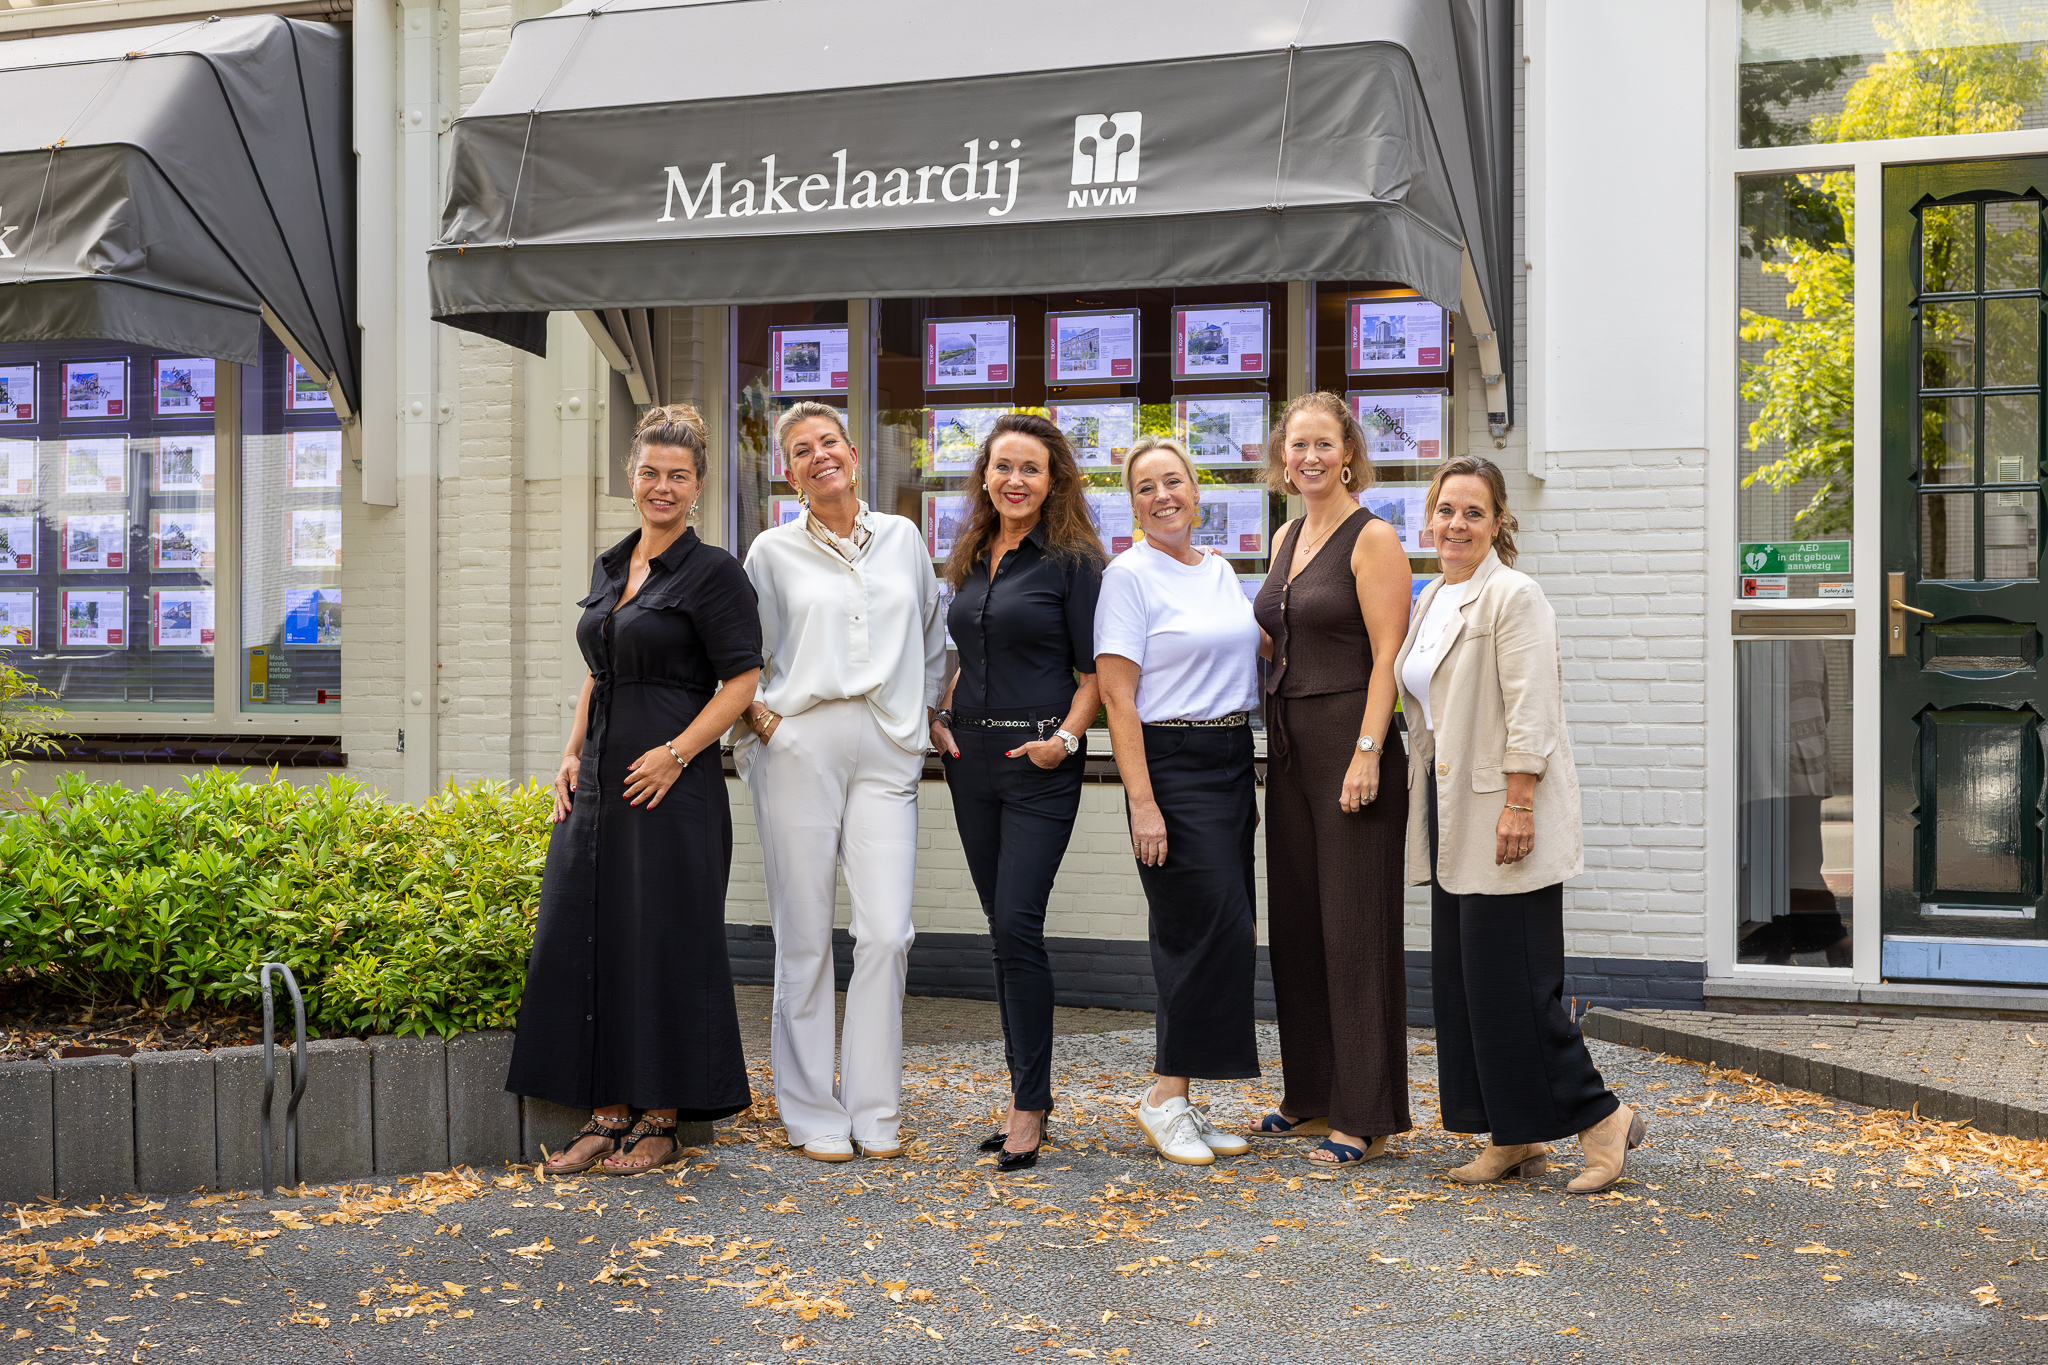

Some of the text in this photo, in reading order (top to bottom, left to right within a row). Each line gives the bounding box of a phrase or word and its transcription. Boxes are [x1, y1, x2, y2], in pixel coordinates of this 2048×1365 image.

[657, 137, 1021, 222] Makelaardij
[1067, 186, 1137, 208] NVM
[72, 371, 110, 398] VERKOCHT
[171, 366, 204, 405] VERKOCHT
[1374, 404, 1419, 450] VERKOCHT
[170, 442, 203, 484] VERHUURD
[1787, 562, 1831, 571] aanwezig
[1804, 553, 1841, 562] gebouw
